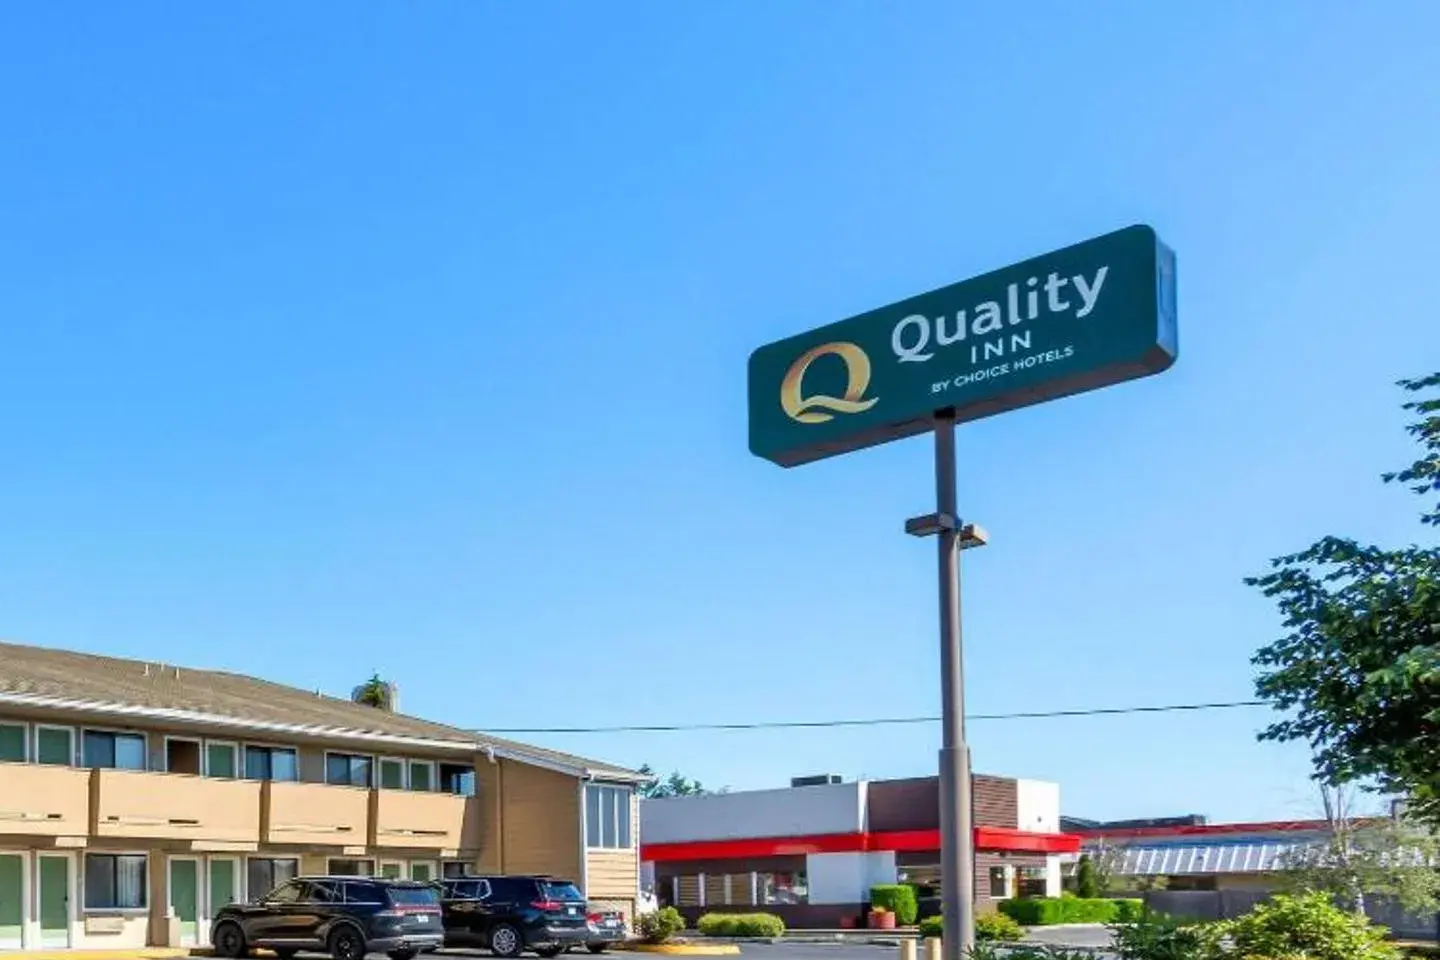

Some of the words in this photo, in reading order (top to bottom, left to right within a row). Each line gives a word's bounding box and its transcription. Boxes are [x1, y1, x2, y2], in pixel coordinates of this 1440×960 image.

[891, 265, 1109, 363] Quality
[971, 330, 1032, 364] INN
[780, 341, 879, 424] Q
[931, 379, 949, 394] BY
[954, 363, 1009, 387] CHOICE
[1013, 345, 1074, 371] HOTELS
